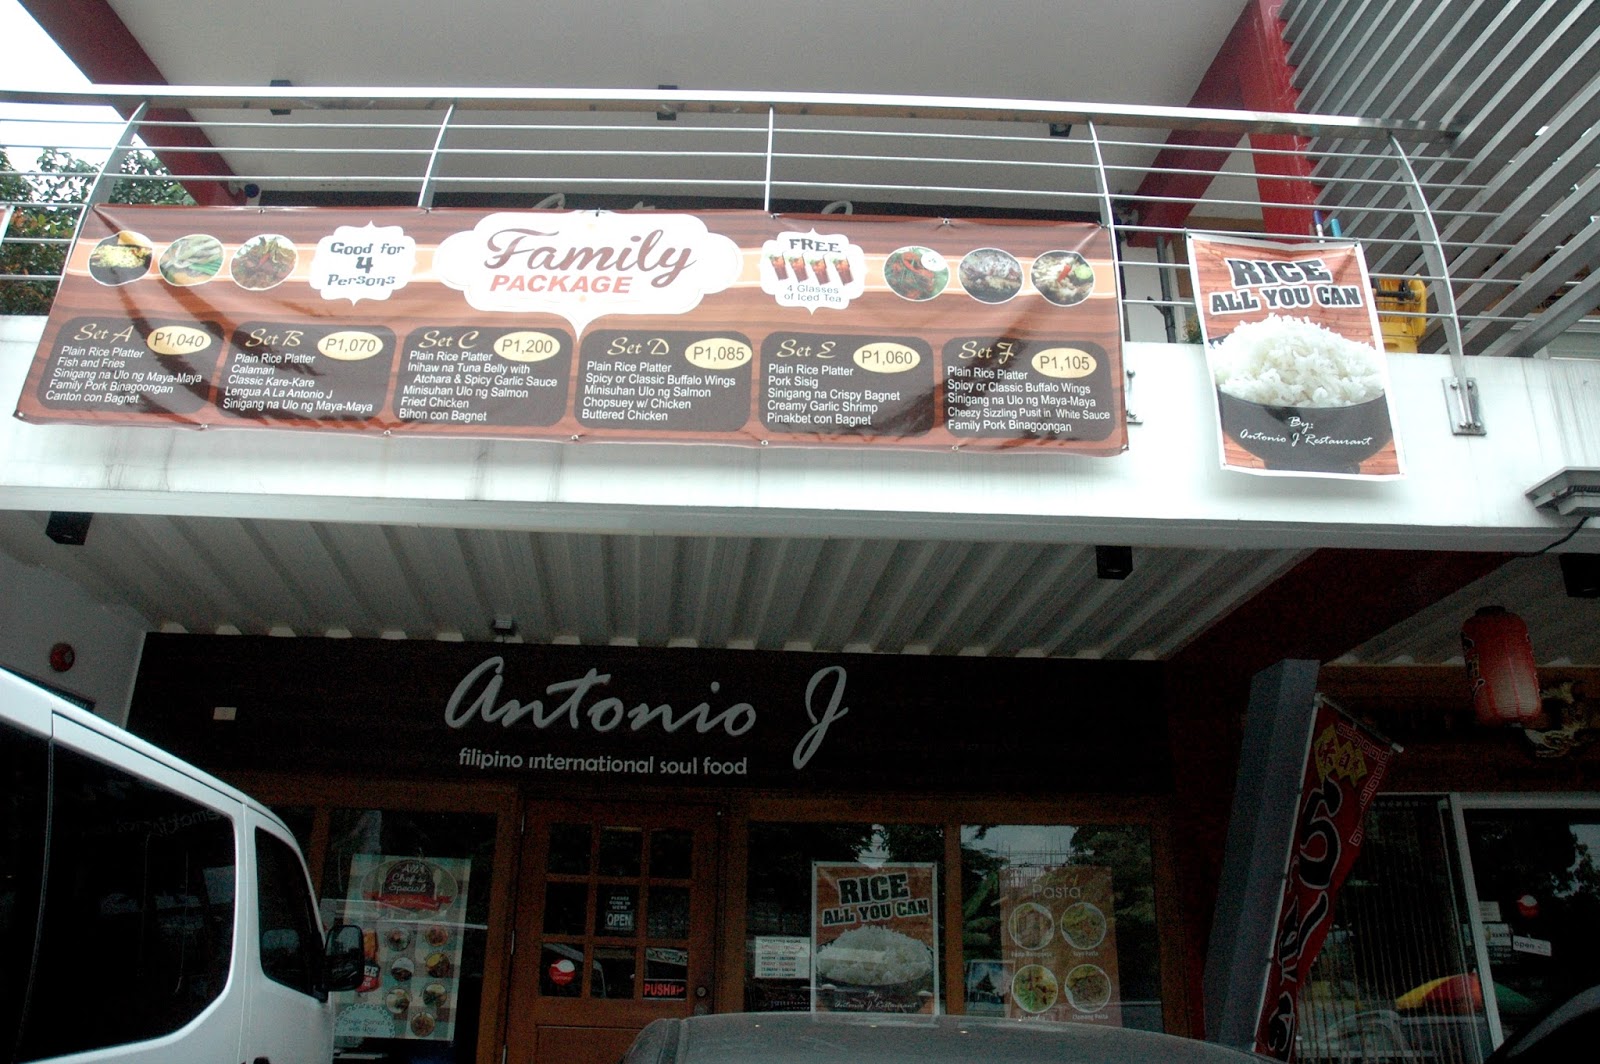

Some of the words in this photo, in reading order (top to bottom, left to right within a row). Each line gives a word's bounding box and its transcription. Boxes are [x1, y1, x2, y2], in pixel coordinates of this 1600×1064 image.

[331, 242, 373, 255] Good
[380, 243, 405, 255] for
[789, 239, 841, 253] FREE
[356, 257, 373, 273] 4
[484, 228, 697, 289] Family
[328, 274, 395, 286] Persons
[1227, 259, 1332, 287] RICE
[489, 274, 633, 294] PACKAGE
[797, 285, 839, 294] Glasses
[825, 294, 841, 302] Tea
[1211, 291, 1259, 313] ALL
[1262, 287, 1310, 307] YOU
[1317, 286, 1361, 306] CAN
[74, 323, 109, 341] Set
[110, 325, 134, 343] A
[154, 332, 205, 347] P1,040
[246, 328, 279, 347] Set
[282, 330, 304, 346] B
[419, 331, 453, 348] Set
[458, 331, 479, 349] C
[61, 346, 85, 355] Plain
[88, 347, 109, 356] Rice
[112, 348, 144, 358] Platter
[326, 339, 376, 353] P1,070
[502, 339, 553, 354] P1,200
[607, 337, 641, 355] Set
[647, 338, 669, 355] D
[777, 339, 811, 357] Set
[817, 341, 836, 358] E
[959, 341, 992, 359] Set
[693, 347, 745, 361] P1,085
[862, 350, 912, 365] P1,060
[57, 357, 79, 367] Fish
[81, 358, 99, 367] and
[102, 359, 125, 368] Fries
[232, 365, 275, 374] Calamari
[408, 363, 439, 372] Inihaw
[457, 363, 480, 372] Tuna
[484, 364, 507, 375] Belly
[511, 365, 530, 373] with
[1040, 356, 1090, 371] P1,105
[54, 369, 96, 381] Sinigang
[114, 372, 129, 380] Ulo
[132, 374, 144, 382] ng
[147, 372, 202, 384] Maya-Maya
[586, 373, 612, 384] Spicy
[629, 374, 664, 384] Classic
[668, 375, 701, 385] Buffalo
[705, 375, 736, 387] Wings
[948, 366, 971, 376] Plain
[974, 368, 994, 378] Rice
[997, 369, 1028, 380] Platter
[50, 380, 82, 392] Family
[85, 381, 107, 391] Pork
[110, 382, 173, 395] Binagoongan
[228, 375, 263, 385] Classic
[266, 377, 314, 387] Kare-Kare
[413, 375, 450, 383] Atchara
[454, 375, 461, 384] &
[465, 375, 492, 386] Spicy
[494, 376, 523, 386] Garlic
[526, 377, 557, 387] Sauce
[769, 376, 791, 385] Pork
[794, 377, 818, 389] Sisig
[948, 380, 973, 392] Spicy
[976, 383, 985, 391] or
[988, 382, 1023, 392] Classic
[1026, 383, 1058, 392] Buffalo
[1061, 383, 1091, 396] Wings
[46, 391, 81, 400] Canton
[84, 393, 102, 401] con
[104, 393, 139, 406] Bagnet
[225, 387, 261, 398] Lengua
[263, 388, 270, 397] A
[273, 388, 285, 397] La
[287, 389, 324, 398] Antonio
[326, 390, 332, 399] J
[403, 386, 453, 395] Minisuhan
[456, 387, 472, 396] Ulo
[476, 389, 488, 398] ng
[491, 388, 528, 398] Salmon
[585, 386, 635, 396] Minisuhan
[639, 387, 655, 396] Ulo
[658, 389, 670, 398] ng
[673, 387, 711, 397] Salmon
[768, 388, 811, 400] Sinigang
[830, 391, 861, 402] Crispy
[865, 390, 900, 402] Bagnet
[223, 398, 264, 411] Sinigang
[267, 401, 278, 409] na
[283, 401, 299, 410] Ulo
[301, 402, 313, 412] ng
[316, 401, 373, 413] Maya-Maya
[401, 397, 426, 406] Fried
[430, 397, 469, 408] Chicken
[583, 397, 633, 410] Chopsuey
[636, 399, 648, 408] w/
[651, 399, 691, 408] Chicken
[768, 400, 806, 412] Creamy
[810, 402, 839, 411] Garlic
[842, 403, 878, 414] Shrimp
[948, 392, 989, 405] Sinigang
[1007, 395, 1023, 405] Ulo
[1026, 397, 1038, 407] ng
[1041, 395, 1096, 408] Maya-Maya
[399, 409, 427, 419] Bihon
[430, 412, 448, 420] con
[451, 410, 487, 422] Bagnet
[582, 409, 624, 419] Buttered
[628, 410, 668, 420] Chicken
[767, 412, 811, 423] Pinakbet
[814, 416, 832, 424] con
[836, 415, 871, 427] Bagnet
[948, 407, 980, 418] Cheezy
[983, 408, 1017, 419] Sizzling
[1020, 409, 1041, 417] Pusit
[1056, 409, 1080, 419] White
[1083, 411, 1110, 419] Sauce
[949, 420, 980, 432] Family
[984, 421, 1006, 429] Pork
[1009, 421, 1072, 433] Binagoongan
[1288, 416, 1313, 435] By:
[1240, 429, 1286, 443] Antonio
[1292, 433, 1300, 447] J
[1305, 434, 1372, 446] Restaurant
[444, 656, 756, 736] Antonio
[792, 665, 848, 769] J
[458, 748, 523, 769] filipino
[529, 754, 654, 774] international
[660, 756, 697, 774] soul
[703, 756, 747, 775] food
[838, 873, 909, 904] RICE
[1033, 884, 1081, 898] Pasta
[823, 910, 855, 925] ALL
[858, 903, 891, 921] YOU
[896, 899, 929, 917] CAN
[607, 913, 631, 927] OPEN
[644, 984, 670, 995] PUSH
